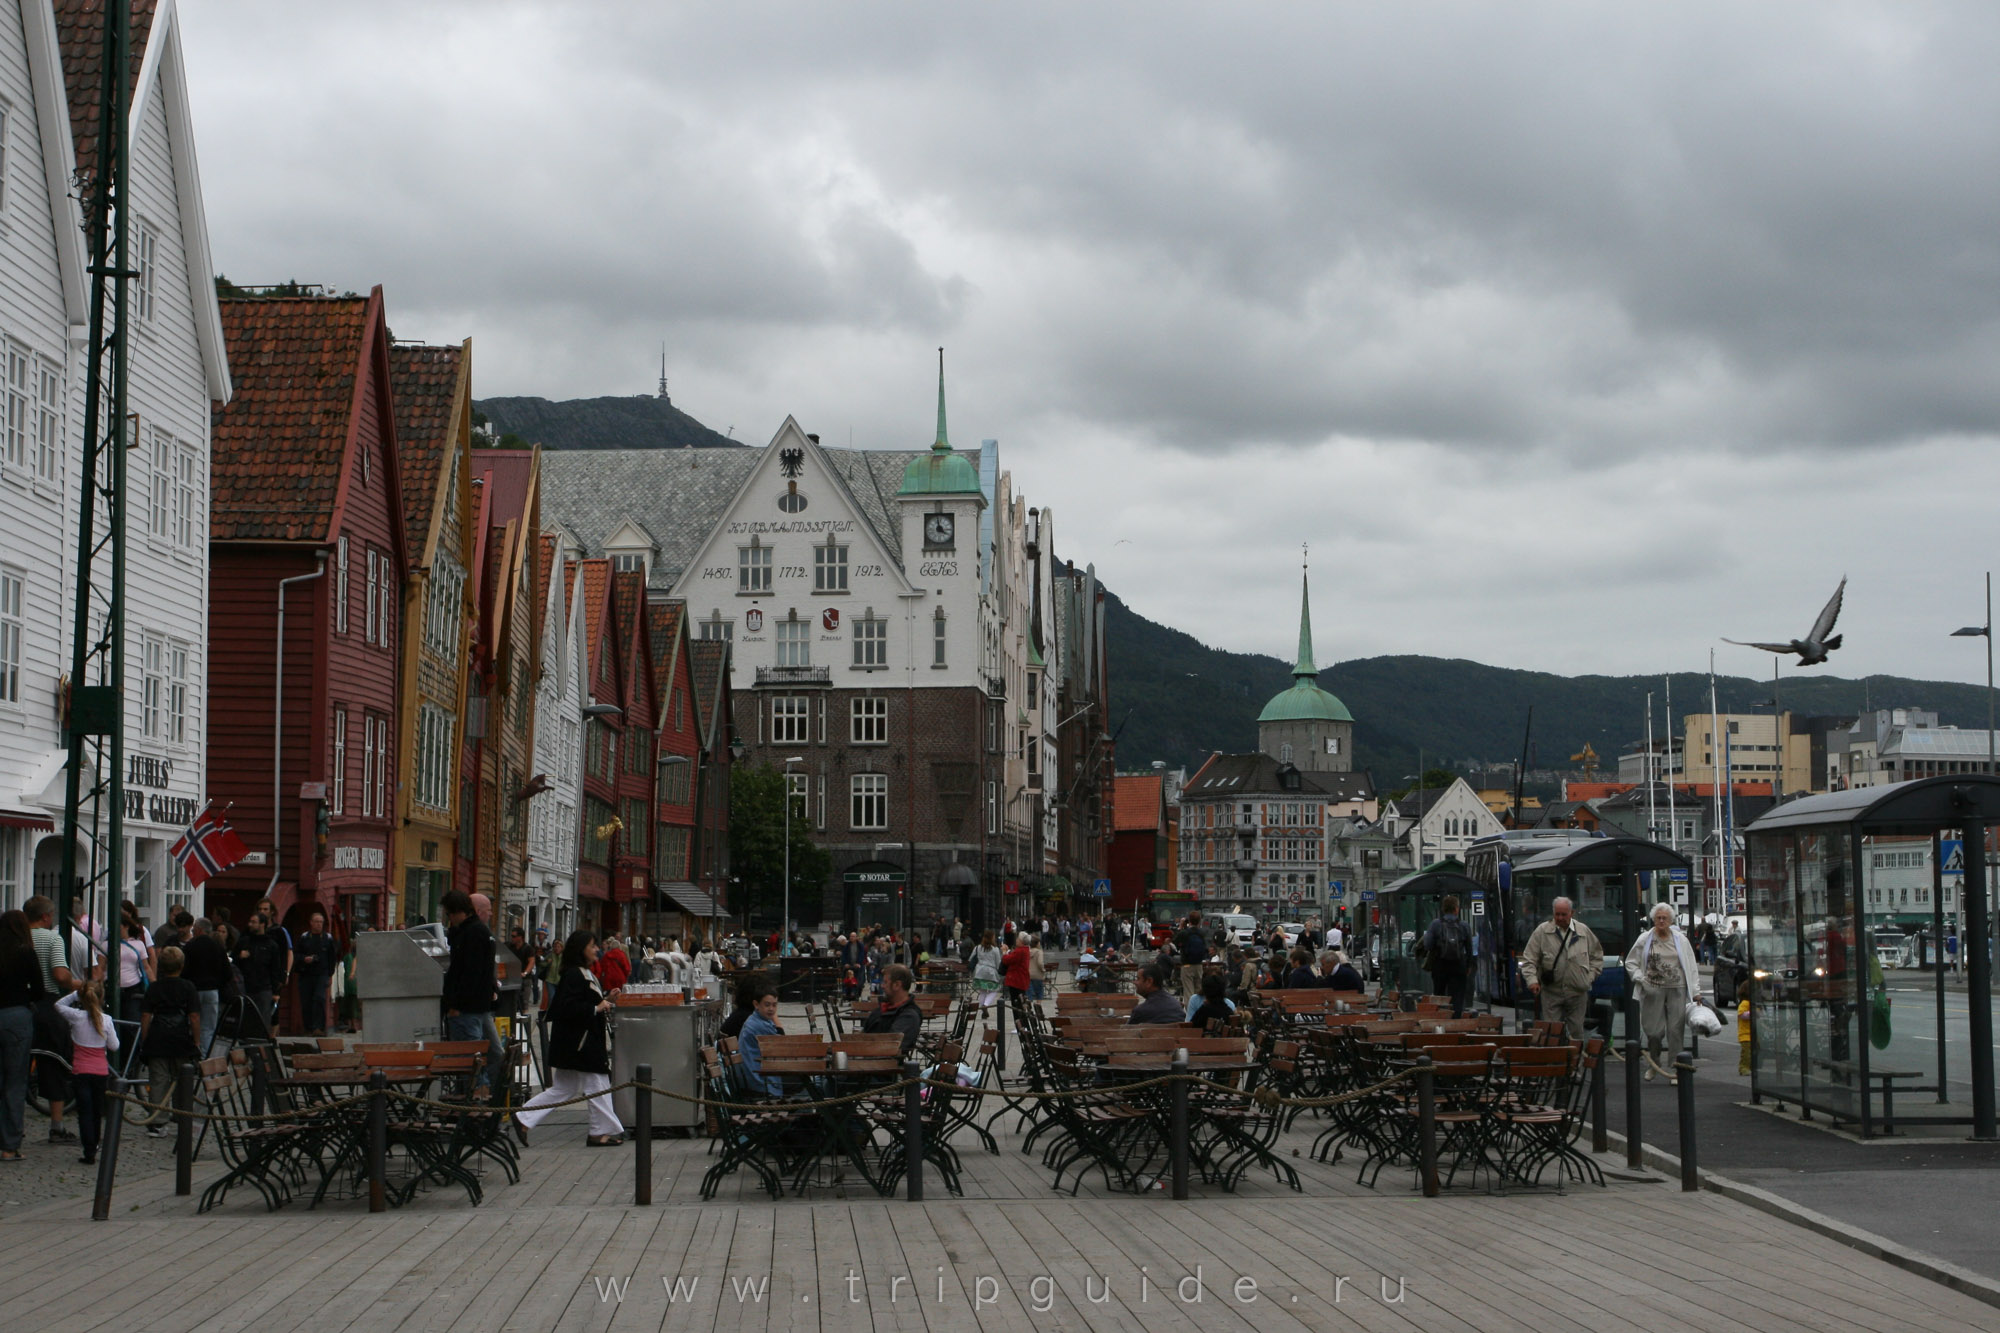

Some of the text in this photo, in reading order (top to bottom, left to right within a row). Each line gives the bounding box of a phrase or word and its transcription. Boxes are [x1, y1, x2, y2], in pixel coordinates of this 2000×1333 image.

[778, 566, 808, 578] 1712.
[854, 565, 884, 577] 1912.
[122, 789, 145, 820] VER
[1674, 886, 1685, 902] F
[1474, 903, 1482, 913] E
